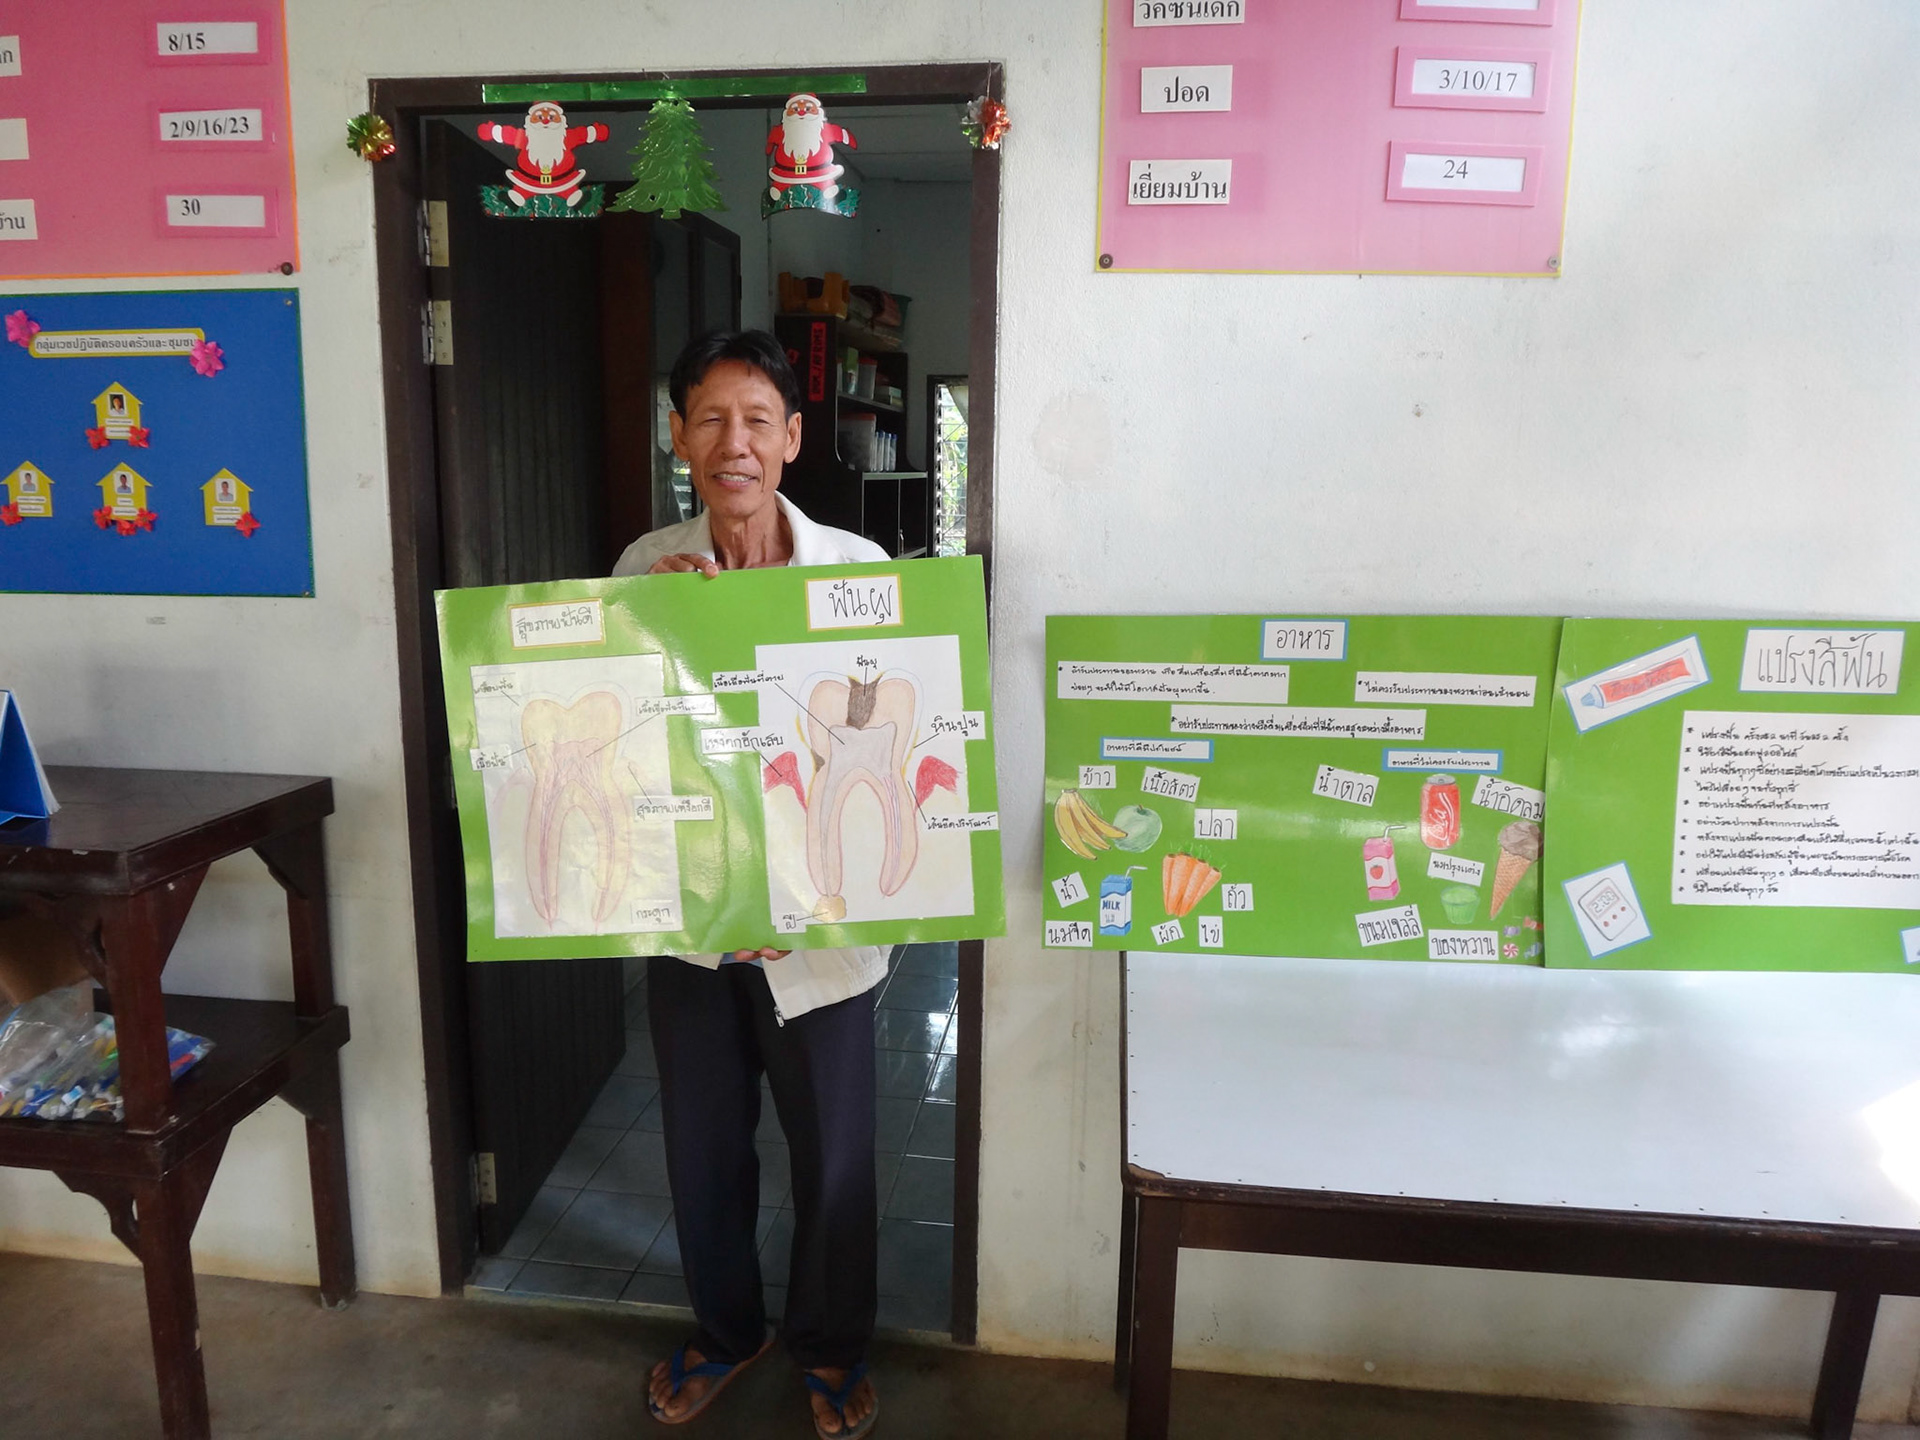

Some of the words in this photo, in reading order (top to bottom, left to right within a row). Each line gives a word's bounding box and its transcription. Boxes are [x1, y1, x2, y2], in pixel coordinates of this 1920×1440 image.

[168, 32, 206, 52] 8/15
[1164, 76, 1210, 103] ปอด
[1439, 69, 1517, 92] 3/10/17
[169, 116, 250, 138] 2/9/16/23
[1443, 159, 1468, 179] 24
[1133, 163, 1227, 199] เยี่ยมบ้าน
[181, 199, 201, 216] 30
[828, 579, 893, 625] ฟันผุ
[515, 606, 595, 642] สุขภาพฟันดี
[1276, 629, 1335, 650] อาหาร
[1758, 632, 1888, 688] แปรงสีฟัน
[931, 714, 979, 737] หินปูน
[1083, 768, 1112, 786] ข้าว
[1318, 768, 1375, 803] น้ำตาล
[1198, 808, 1235, 839] ปลา
[1061, 876, 1079, 900] น้ำ
[1102, 900, 1120, 910] MILK
[1159, 925, 1182, 943] ผัก
[1201, 924, 1220, 943] ไข่
[1432, 936, 1496, 956] ของหวาน
